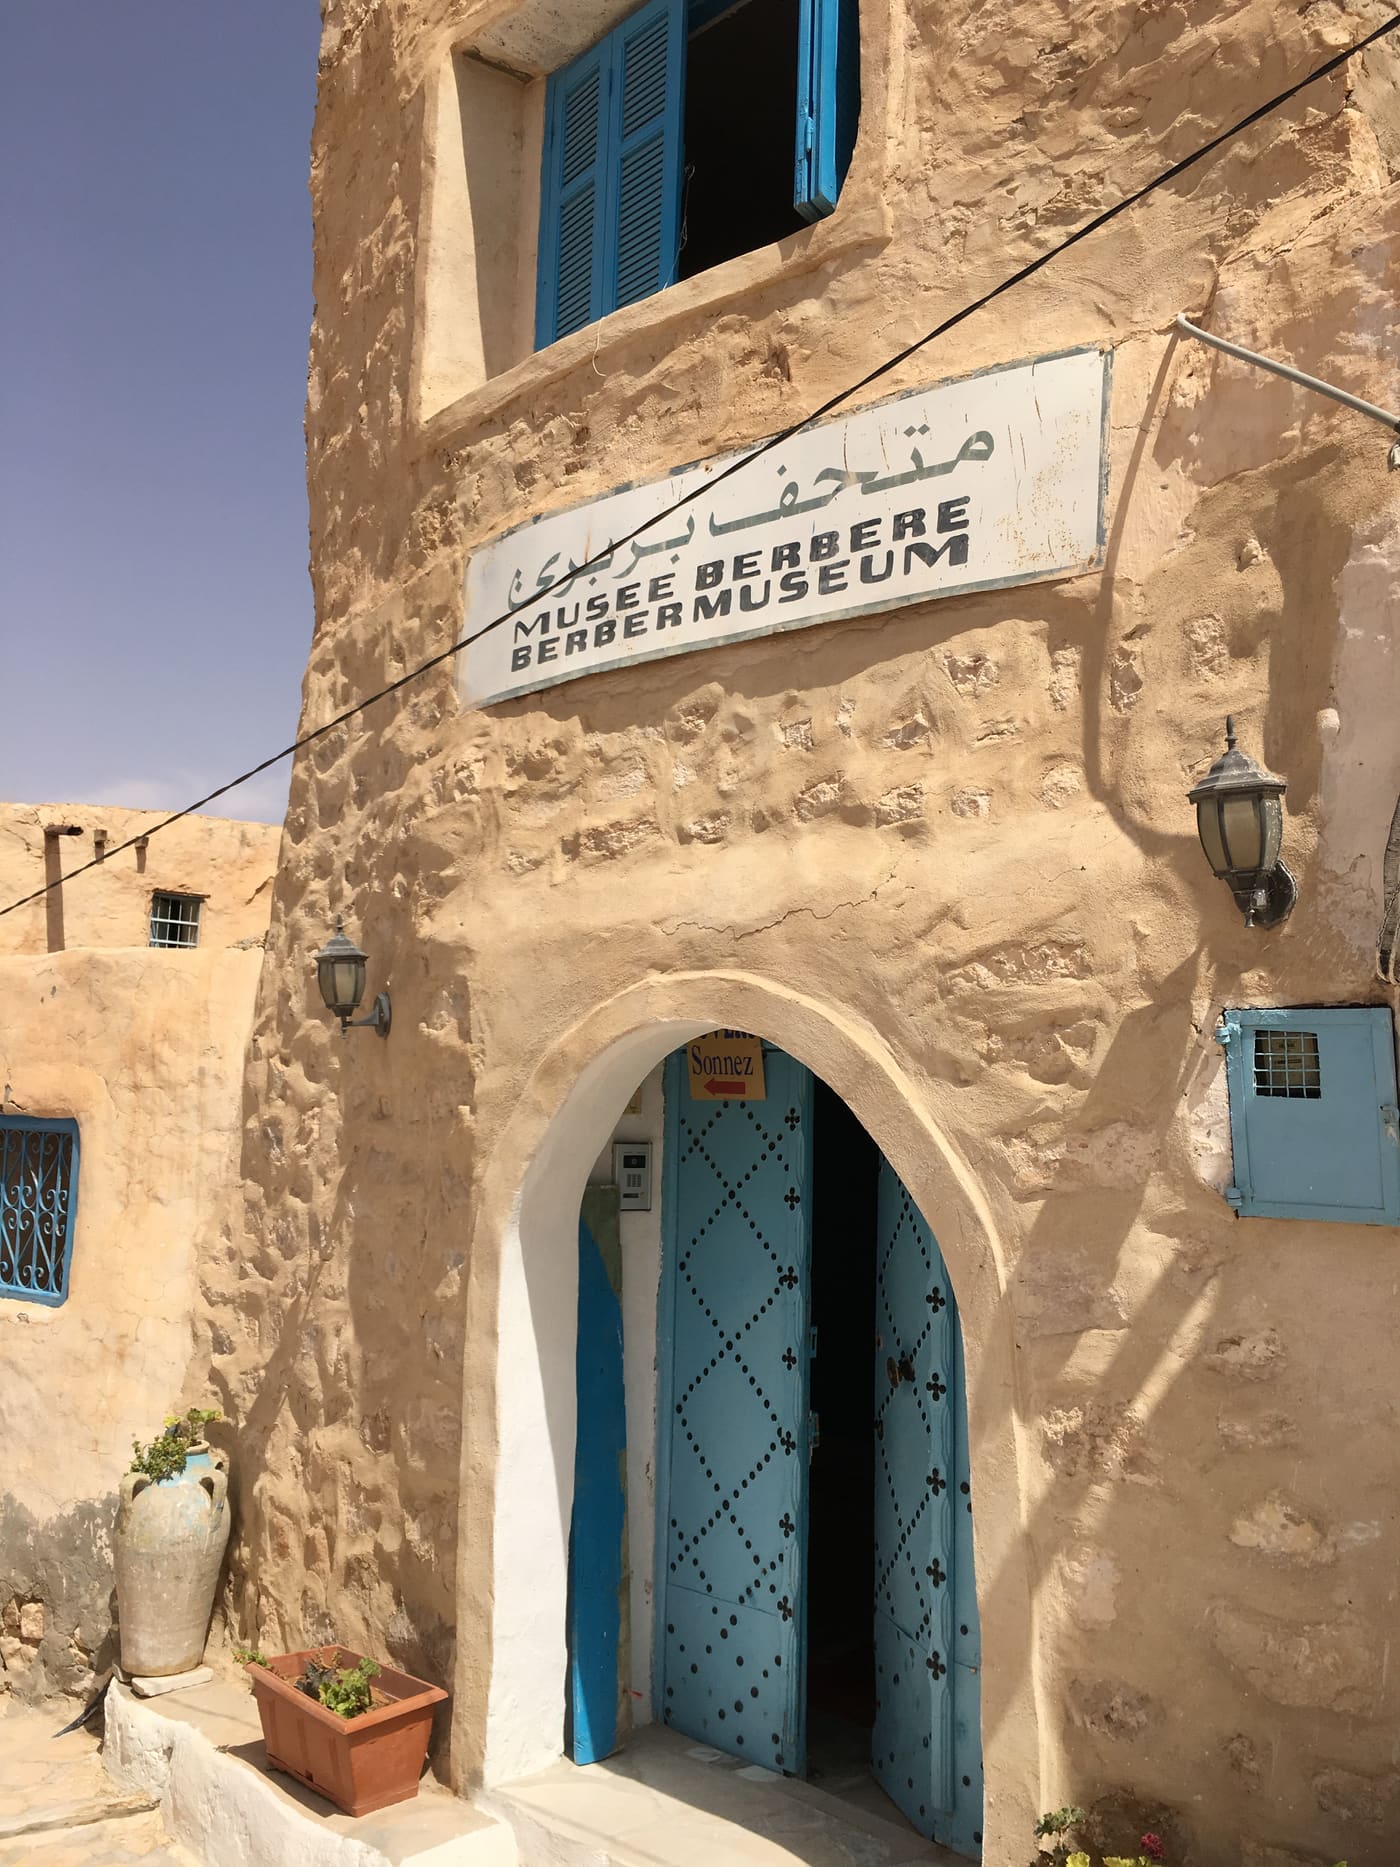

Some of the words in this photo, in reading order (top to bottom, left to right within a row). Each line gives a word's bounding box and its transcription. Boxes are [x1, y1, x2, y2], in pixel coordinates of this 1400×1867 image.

[708, 424, 995, 535] متحف
[511, 533, 970, 672] BERBERMUSEUM
[514, 572, 676, 644] MUSEE
[694, 495, 971, 592] BERBERE
[691, 1045, 754, 1076] Sonnez
